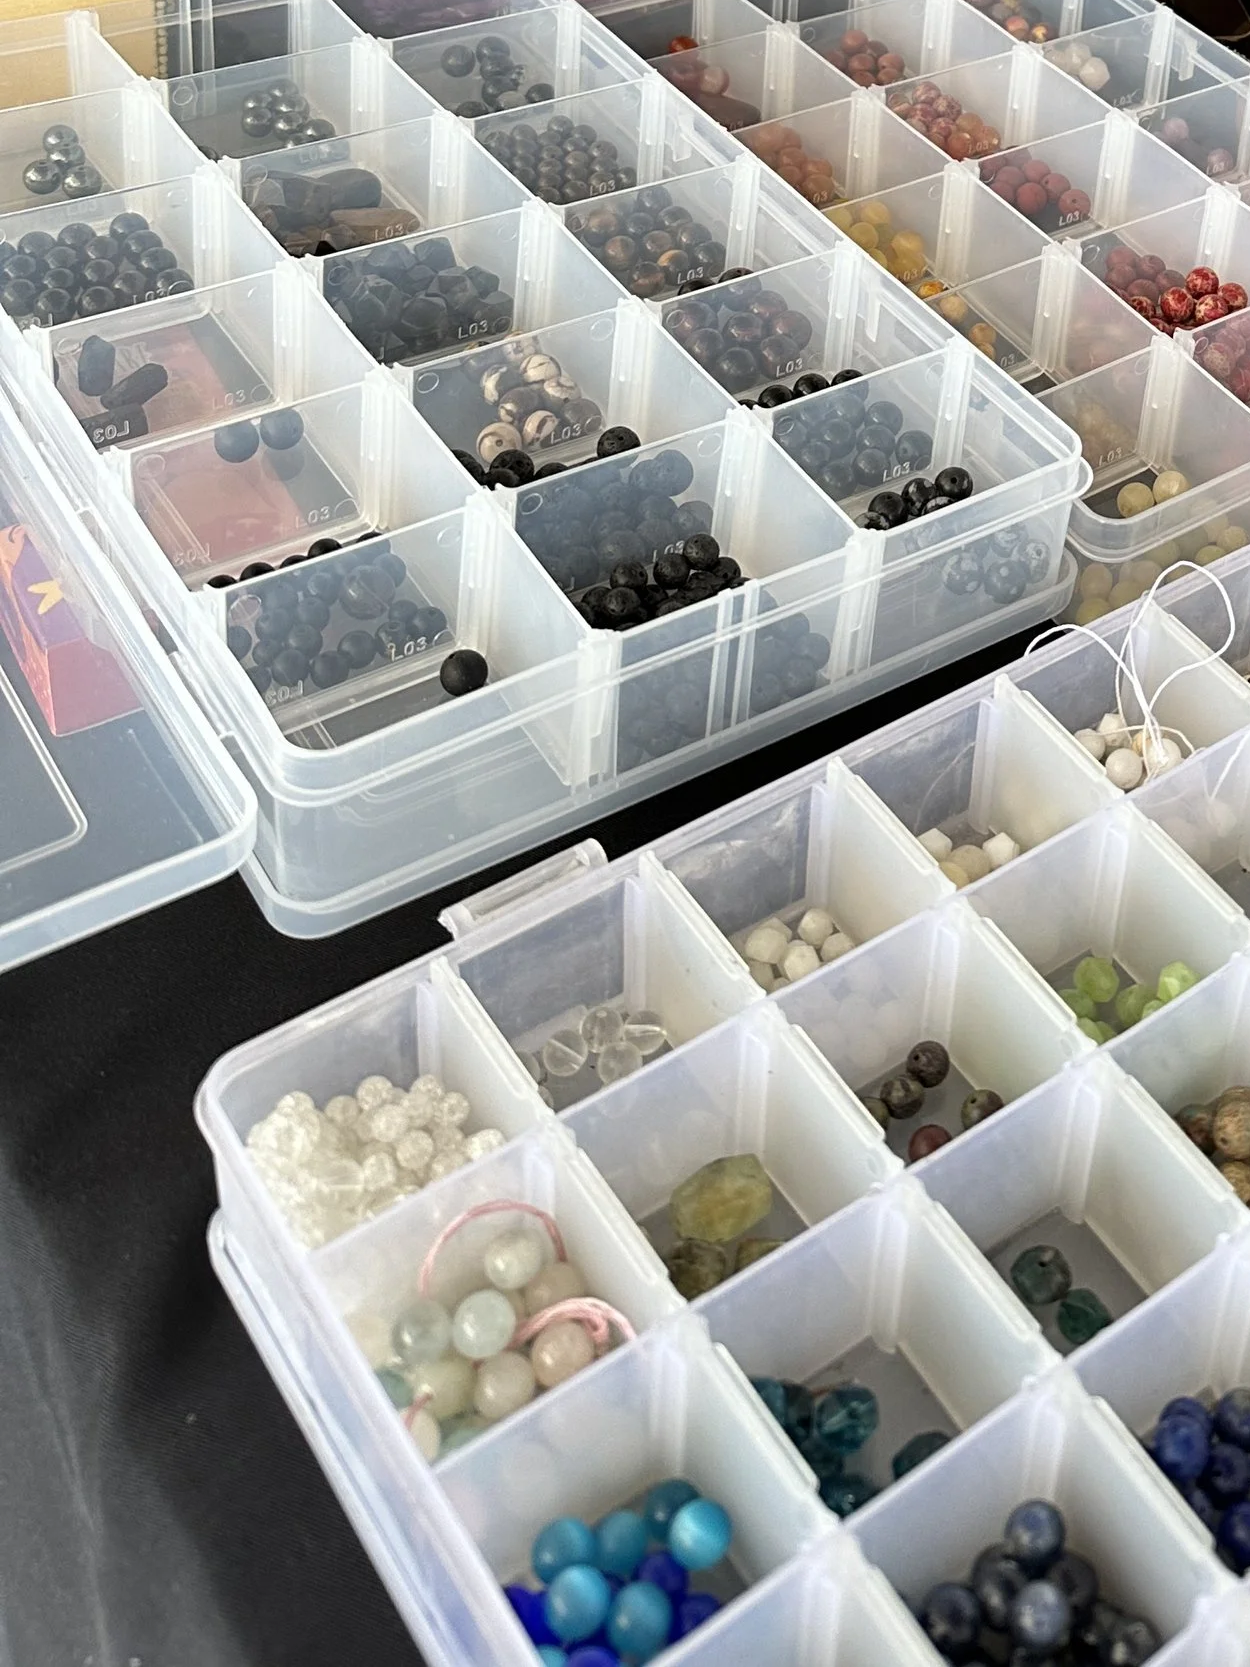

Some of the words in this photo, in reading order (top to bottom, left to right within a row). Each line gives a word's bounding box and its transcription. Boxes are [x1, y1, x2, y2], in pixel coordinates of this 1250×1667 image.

[590, 180, 616, 197] L03
[1059, 213, 1080, 227] L03
[374, 223, 404, 241] L03
[677, 267, 704, 285] L03
[458, 320, 489, 340] L03
[776, 358, 803, 378] L03
[212, 389, 246, 410] L03
[551, 423, 582, 444] L03
[883, 462, 911, 482] L03
[295, 506, 330, 530] L03
[391, 637, 428, 662] L03
